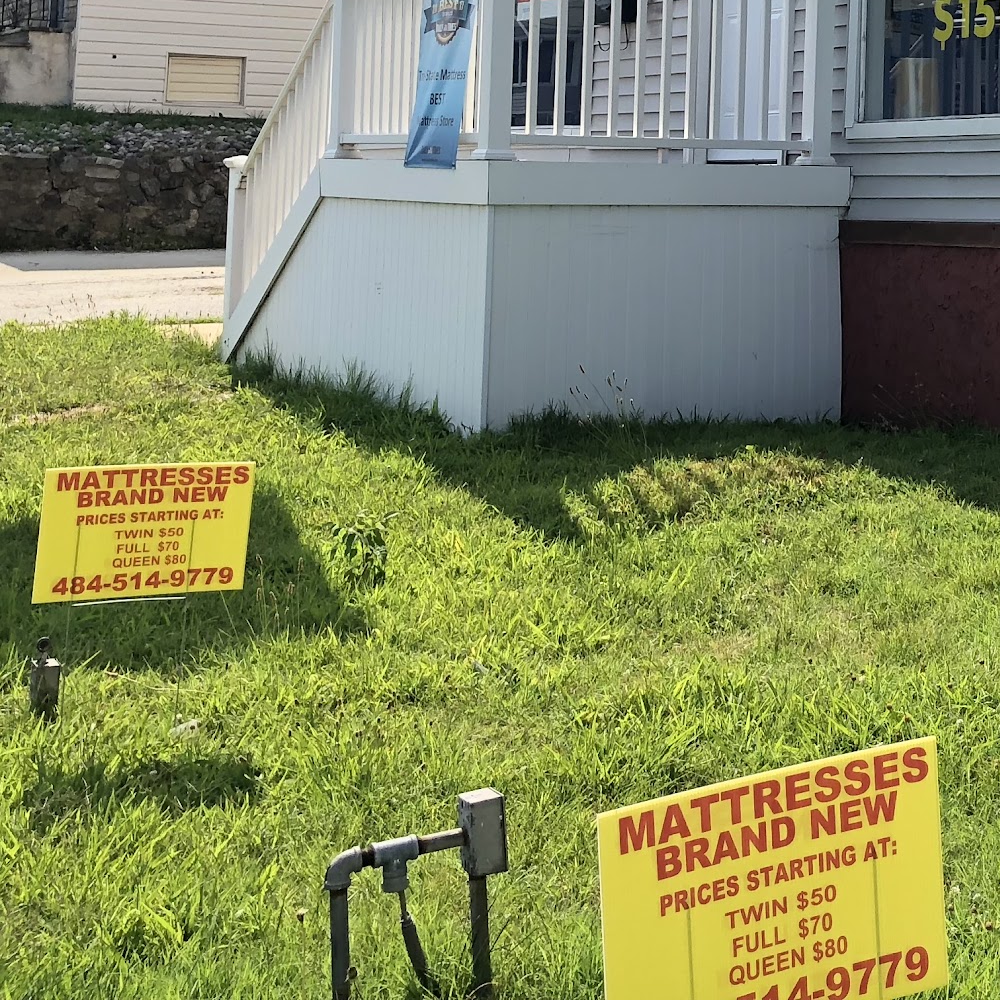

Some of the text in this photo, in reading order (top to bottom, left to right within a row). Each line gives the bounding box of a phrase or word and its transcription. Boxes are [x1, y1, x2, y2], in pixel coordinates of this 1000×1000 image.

[56, 466, 250, 491] MATTRESSES
[76, 486, 229, 508] BRAND NEW
[76, 508, 224, 526] PRICES STARTING AT:
[114, 526, 184, 540] TWIN $50
[116, 540, 179, 554] FULL $70
[112, 554, 187, 569] QUEEN $80
[52, 566, 234, 595] 484-514-9779
[618, 746, 929, 855] MATTRESSES
[655, 791, 898, 881] BRAND NEW
[660, 836, 898, 917] PRICES STARTING AT:
[725, 884, 837, 930] TWIN $50
[732, 912, 833, 958] FULL $70
[728, 935, 848, 986] QUEEN $80
